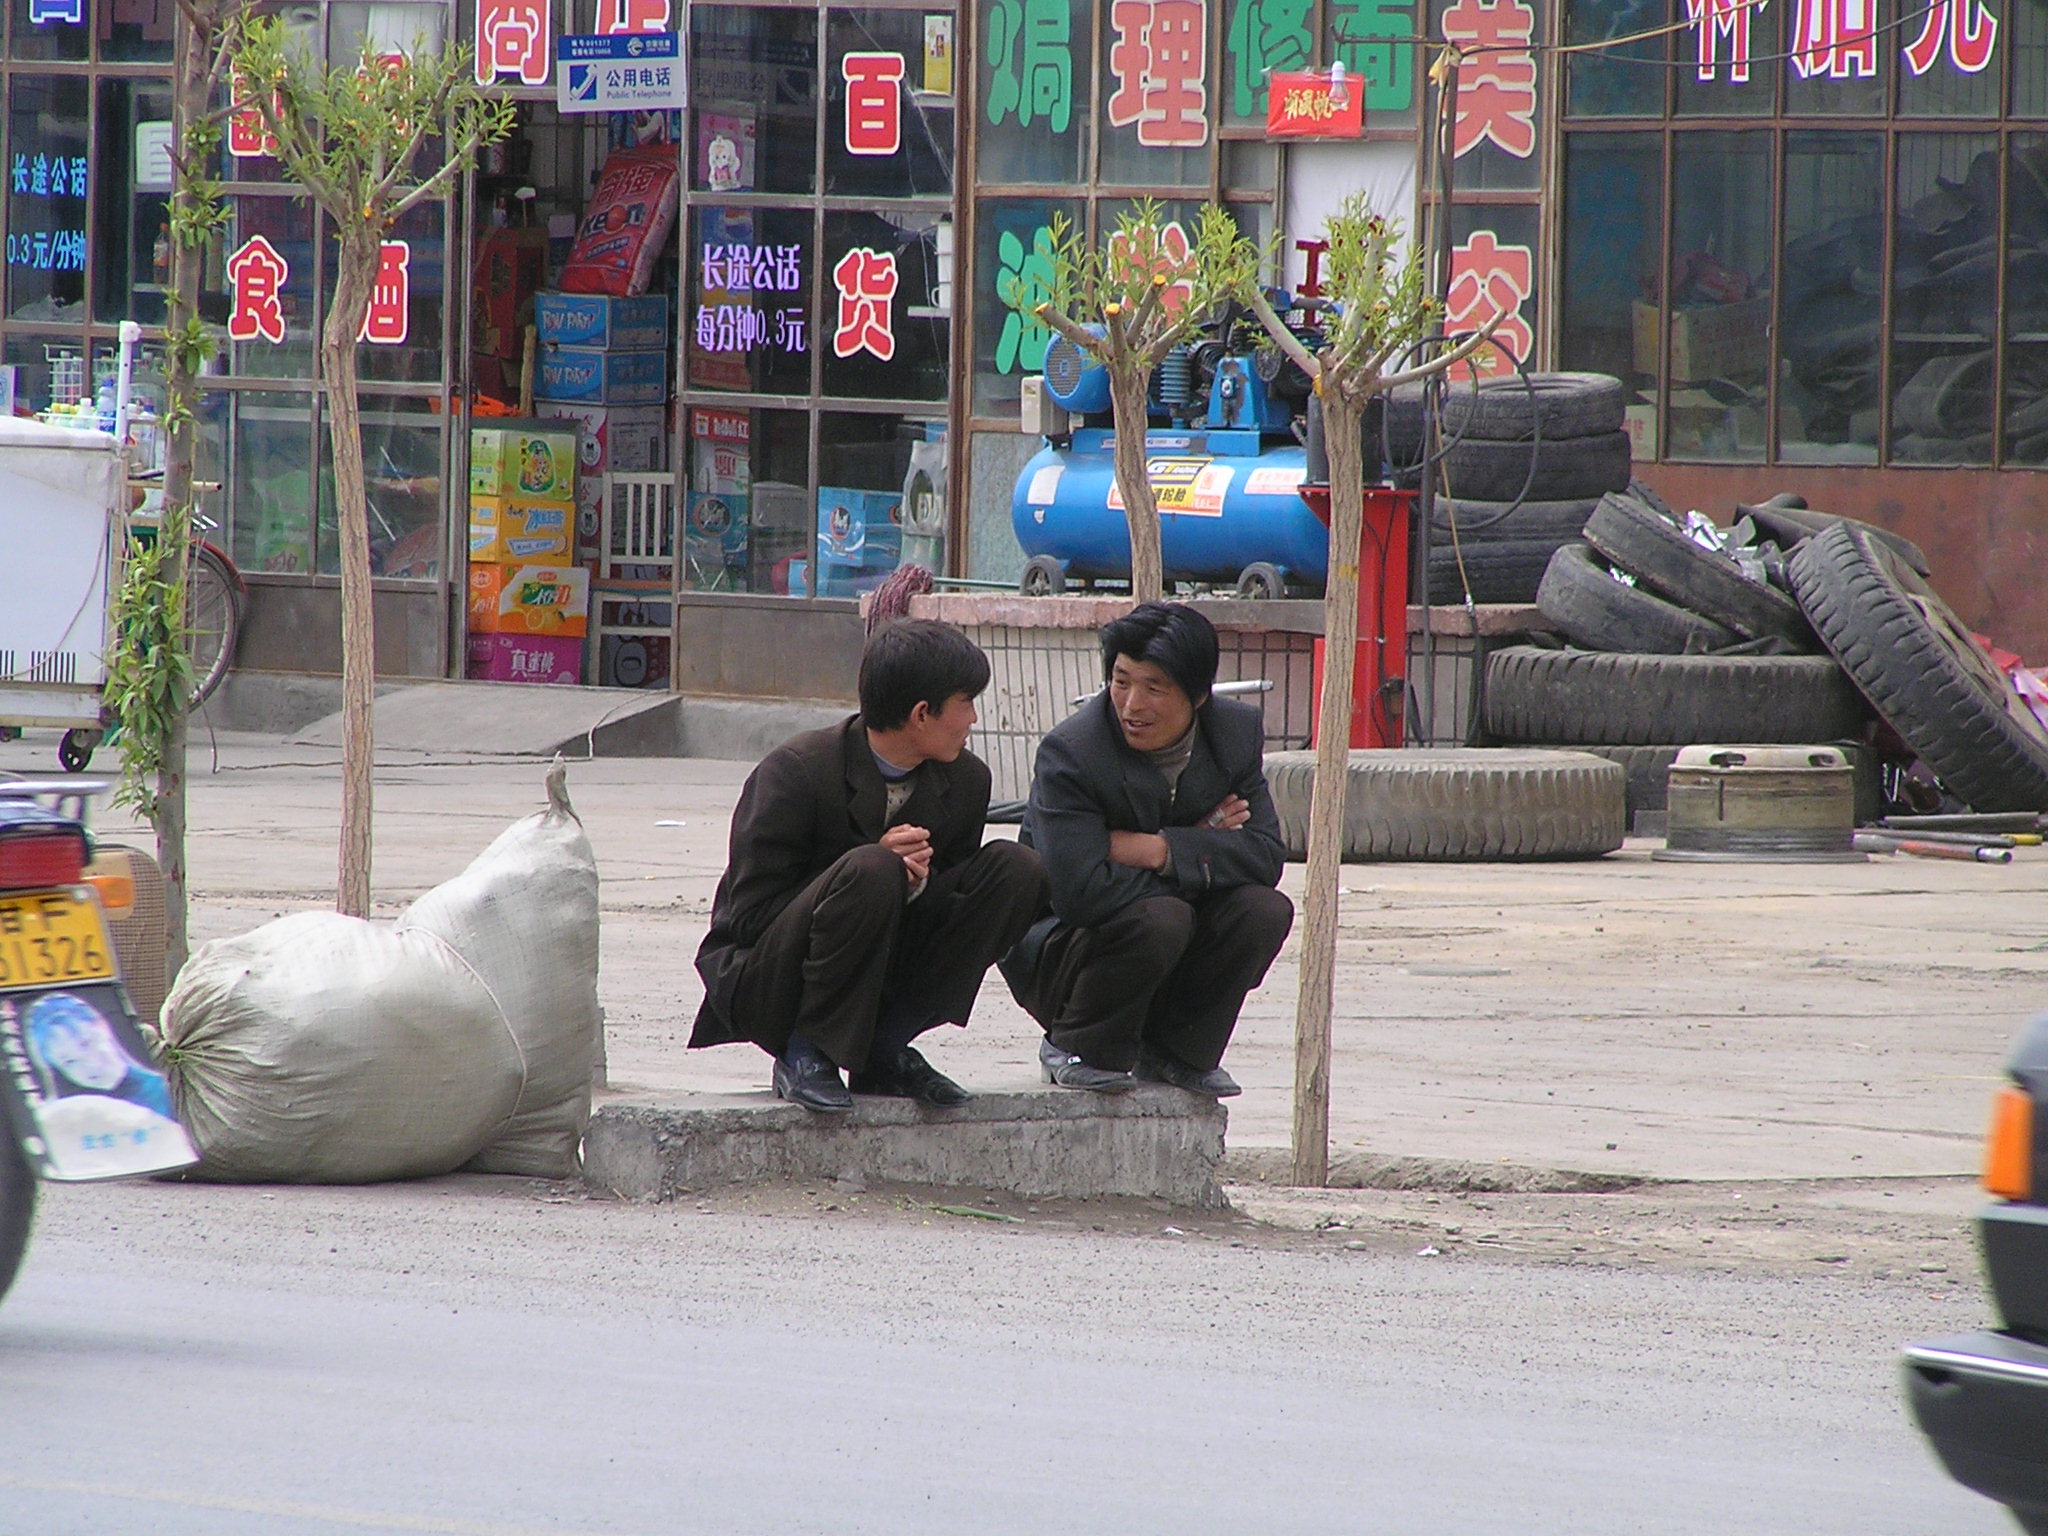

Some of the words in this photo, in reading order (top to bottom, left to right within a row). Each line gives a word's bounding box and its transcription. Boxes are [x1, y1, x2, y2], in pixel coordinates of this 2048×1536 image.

[607, 67, 671, 87] 公用电话
[607, 91, 629, 99] Public
[632, 90, 672, 99] Telephone
[12, 152, 86, 196] 长途公话
[834, 52, 905, 361] 百货
[6, 229, 86, 271] 0.3元/分钟
[701, 243, 800, 290] 长途公话
